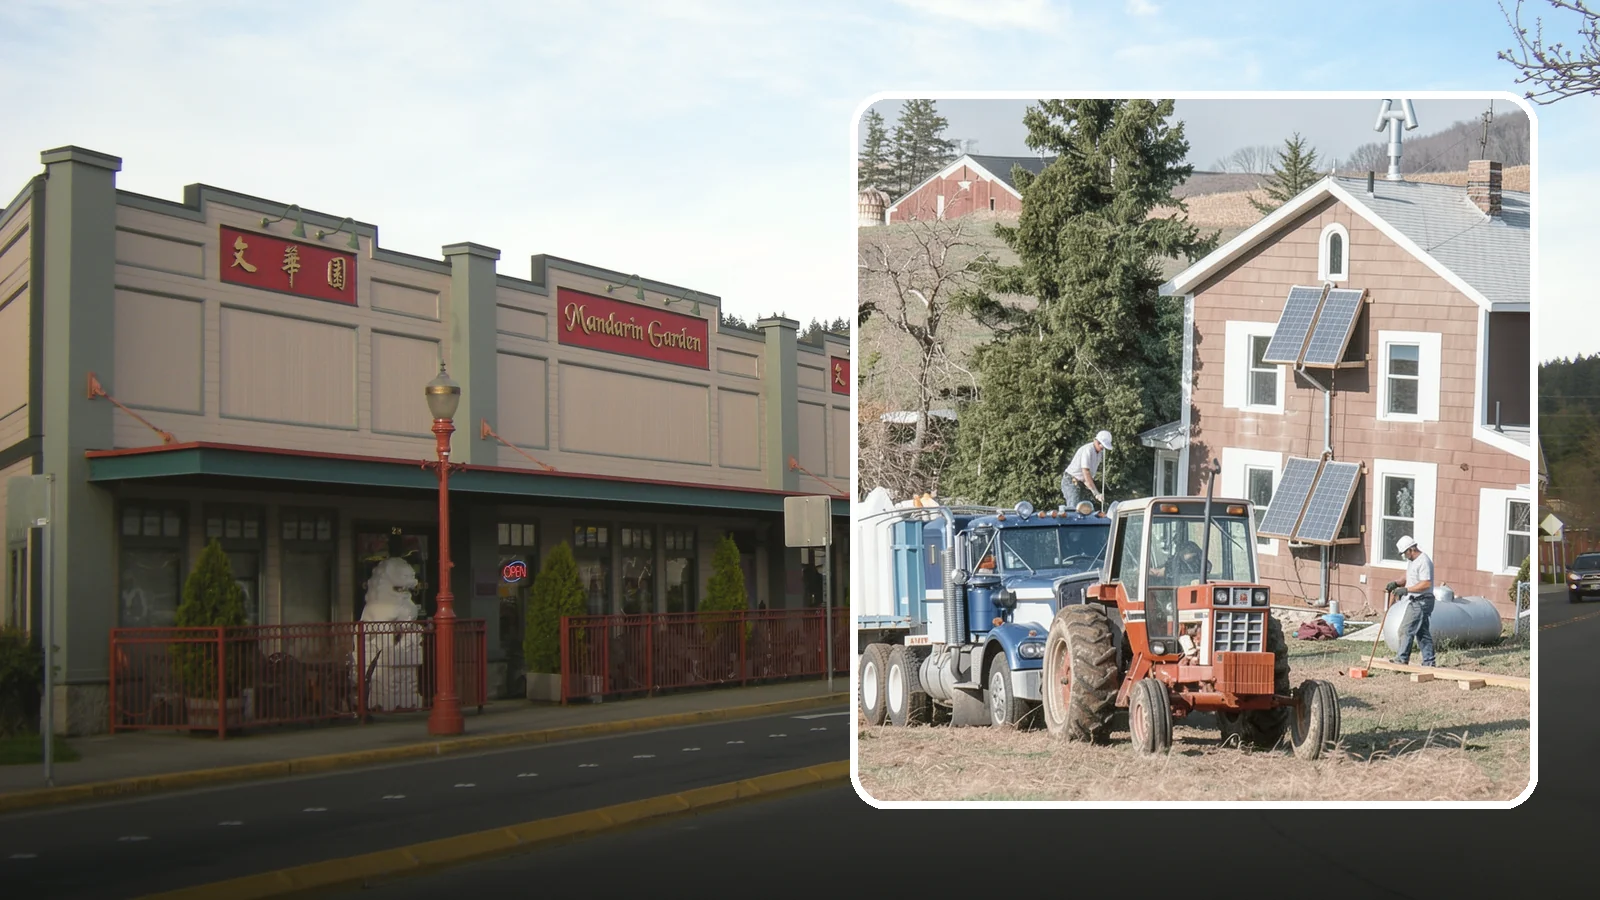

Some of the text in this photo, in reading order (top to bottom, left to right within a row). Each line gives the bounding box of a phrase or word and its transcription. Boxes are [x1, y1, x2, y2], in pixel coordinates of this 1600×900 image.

[231, 236, 346, 290] 文華園
[564, 302, 702, 352] Mandarin Garden
[503, 565, 527, 578] OPEN
